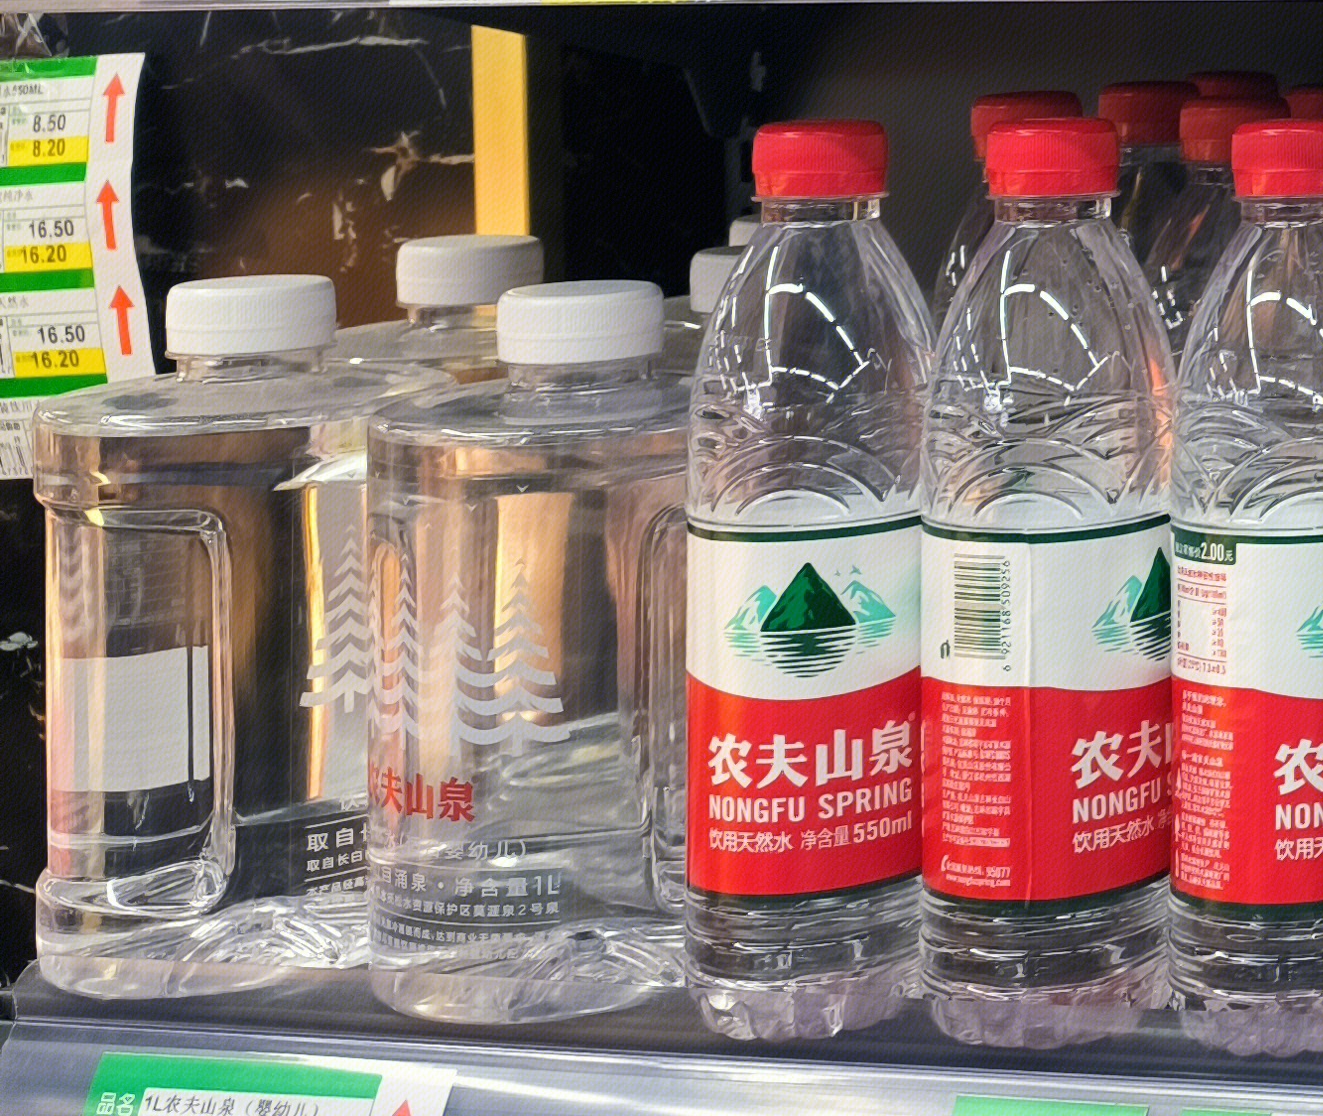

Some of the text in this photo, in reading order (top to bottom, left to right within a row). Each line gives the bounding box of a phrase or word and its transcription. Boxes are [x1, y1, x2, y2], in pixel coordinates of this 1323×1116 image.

[33, 113, 67, 133] 8.50
[33, 138, 66, 157] 8.20
[29, 219, 74, 239] 16.50
[22, 244, 67, 264] 16.20
[38, 325, 86, 344] 16.50
[31, 350, 80, 369] 16.20
[708, 719, 912, 790] 农夫山泉
[708, 777, 913, 824] NONGFU SPRING
[1072, 778, 1162, 824] NONGFU
[708, 829, 793, 854] 饮用天然水
[1072, 815, 1155, 854] 饮用天然水
[97, 1092, 135, 1116] 品名
